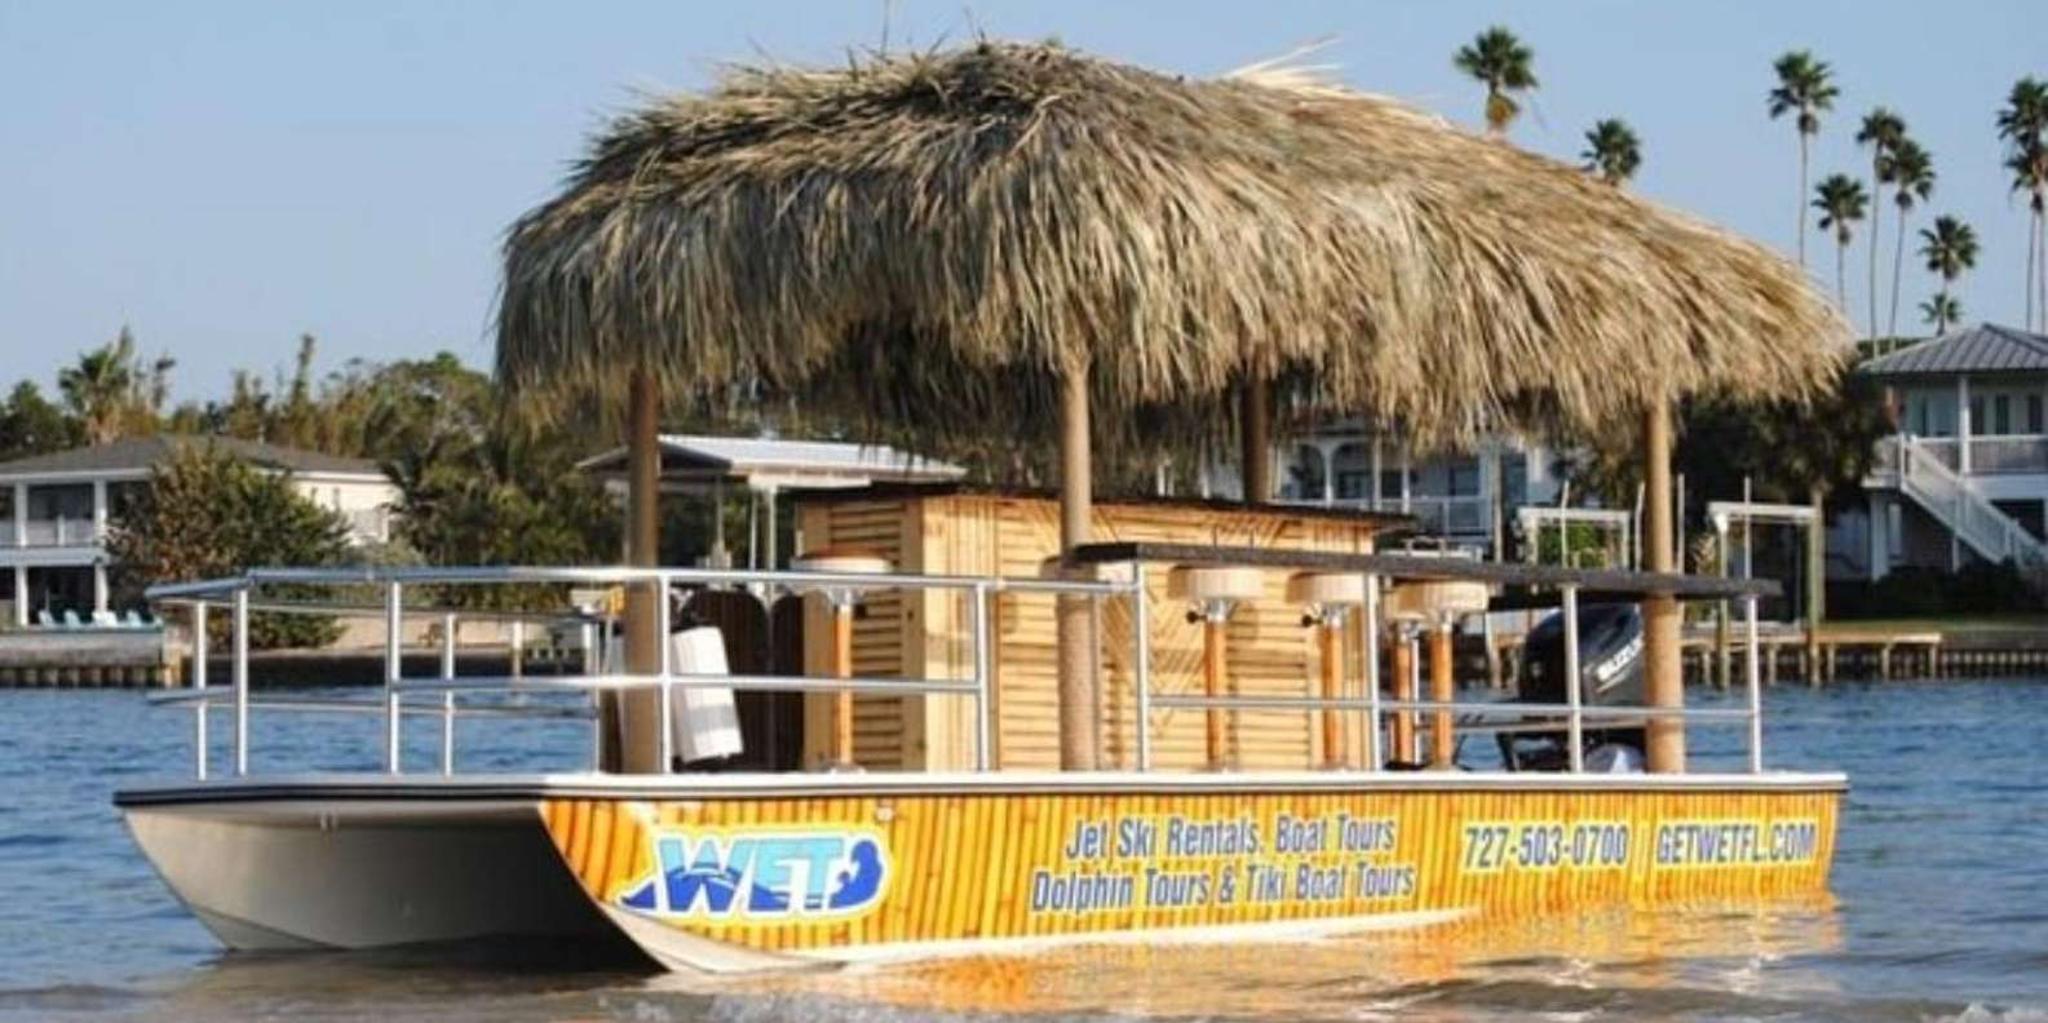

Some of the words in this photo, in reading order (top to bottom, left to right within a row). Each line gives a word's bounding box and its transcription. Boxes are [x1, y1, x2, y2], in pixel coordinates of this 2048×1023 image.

[1595, 637, 1644, 681] SUZU
[1065, 819, 1107, 859] Jet
[1117, 817, 1157, 857] Ski
[1275, 815, 1327, 853] Boat
[1337, 813, 1395, 852] Tours
[1465, 824, 1629, 868] 727-503-0700
[1656, 822, 1815, 864] GETWETFL.COM
[657, 838, 845, 913] WET
[1032, 868, 1135, 913] Dolphin
[1143, 867, 1211, 909] Tours
[1216, 865, 1236, 904] &
[1246, 864, 1287, 903] Tiki
[1296, 862, 1347, 900] Boat
[1355, 861, 1414, 897] Tours
